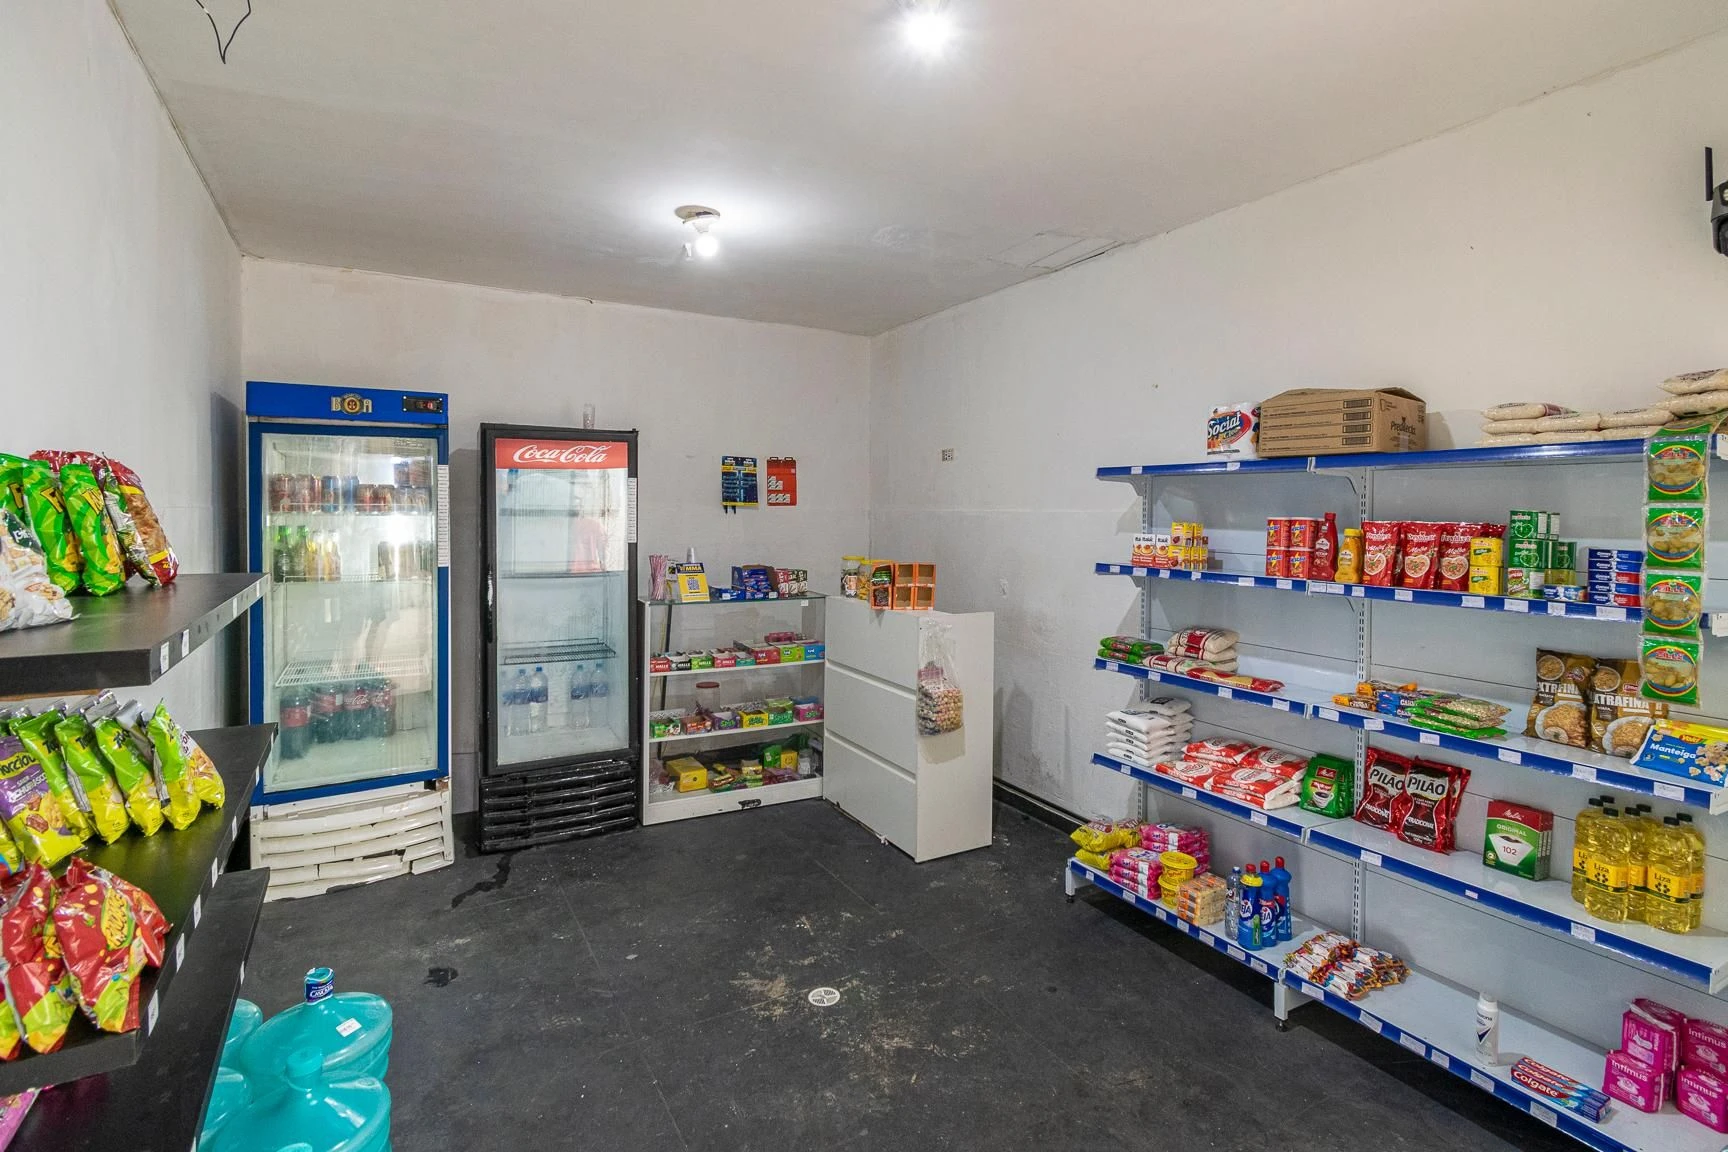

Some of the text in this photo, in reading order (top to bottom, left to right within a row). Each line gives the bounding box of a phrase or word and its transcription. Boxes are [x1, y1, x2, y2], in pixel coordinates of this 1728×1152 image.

[1208, 411, 1241, 438] Social
[513, 444, 612, 463] Coca-Cola
[1650, 743, 1696, 759] Manteiga
[1370, 768, 1404, 791] PILÃO
[1407, 776, 1446, 796] PILÃO
[1496, 823, 1527, 837] ORIGINAL
[1503, 846, 1517, 856] 102
[1594, 863, 1610, 873] Liza
[1655, 873, 1672, 884] Liza
[1689, 1028, 1727, 1049] Intimus
[1612, 1060, 1648, 1081] Intimus
[1514, 1071, 1558, 1097] Colgate
[1681, 1077, 1718, 1099] Intimus
